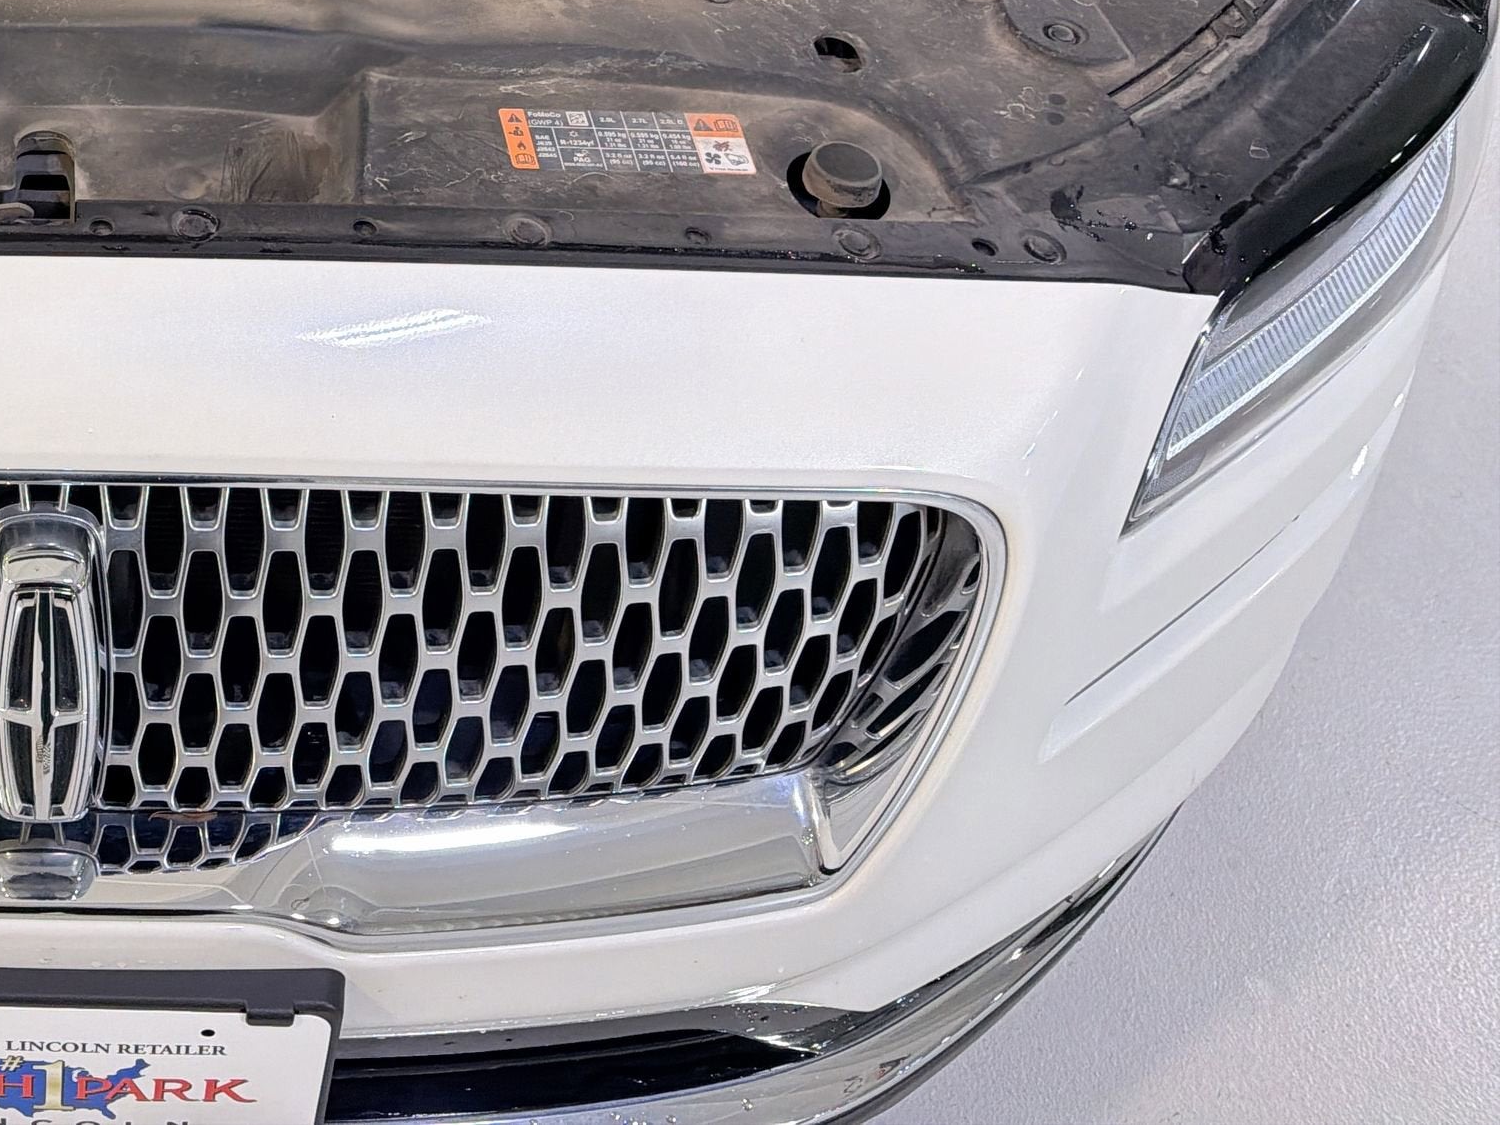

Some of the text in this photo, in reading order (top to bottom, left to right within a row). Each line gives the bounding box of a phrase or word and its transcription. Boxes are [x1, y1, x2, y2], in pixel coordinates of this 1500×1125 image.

[560, 139, 594, 147] R-1234yf
[6, 1040, 110, 1054] LINCOLN
[117, 1044, 227, 1056] RETAILER
[75, 1075, 257, 1103] PARK
